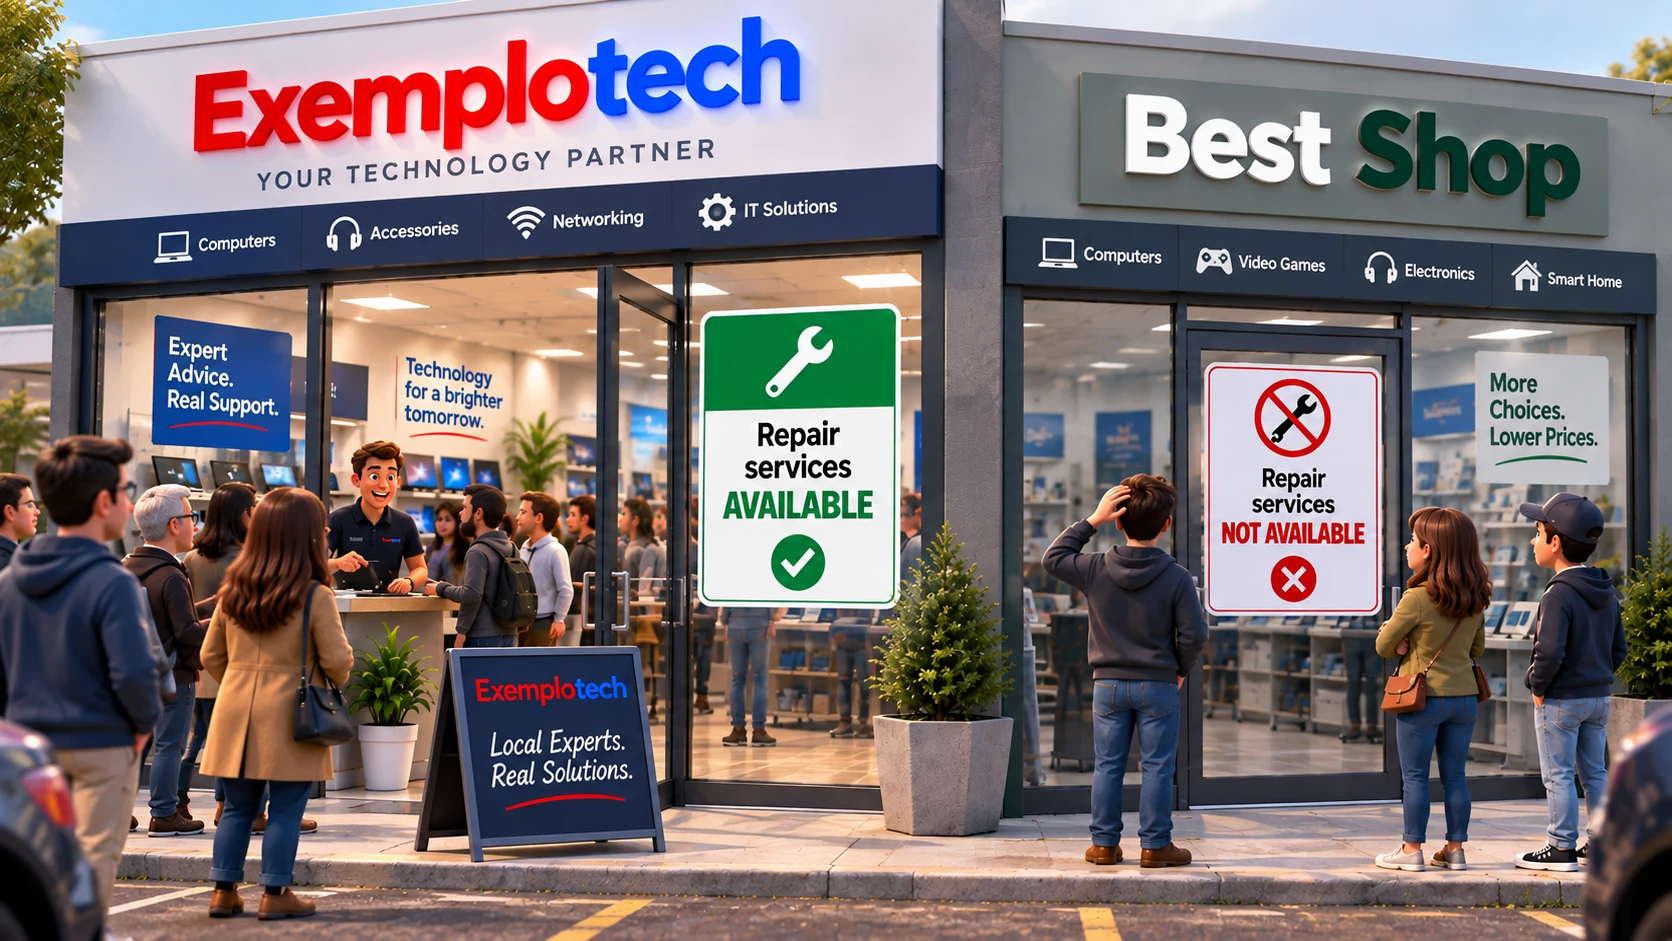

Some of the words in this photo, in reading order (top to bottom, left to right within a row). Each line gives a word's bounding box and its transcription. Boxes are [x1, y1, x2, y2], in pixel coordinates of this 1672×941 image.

[194, 16, 801, 152] Exemplotech
[257, 168, 331, 191] YOUR
[348, 151, 551, 183] TECHNOLOGY
[568, 139, 714, 167] PARTNER
[1126, 94, 1331, 185] Best
[1354, 110, 1581, 219] Shop
[554, 210, 643, 228] Networking
[745, 203, 759, 217] IT
[763, 200, 837, 216] Solutions
[370, 221, 459, 240] Accessories
[199, 235, 275, 252] Computers
[1084, 247, 1162, 265] Computers
[1239, 255, 1277, 269] Video
[1281, 257, 1325, 272] Games
[1406, 264, 1475, 280] Electronics
[1548, 272, 1584, 286] Smart
[1588, 275, 1622, 288] Home
[169, 336, 228, 362] Expert
[168, 363, 234, 388] Advice.
[405, 356, 493, 389] Technology
[1491, 373, 1537, 393] More
[168, 389, 206, 411] Real
[209, 393, 279, 418] Support.
[405, 380, 428, 399] for
[432, 389, 440, 401] a
[445, 385, 503, 409] brighter
[405, 405, 484, 429] tomorrow.
[1490, 399, 1565, 420] Choices.
[758, 420, 840, 452] Repair
[1491, 427, 1542, 446] Lower
[1546, 427, 1598, 446] Prices.
[745, 453, 851, 479] services
[1263, 468, 1326, 490] Repair
[723, 490, 873, 519] AVAILABLE
[1252, 493, 1335, 513] services
[1222, 522, 1261, 544] NOT
[1264, 522, 1365, 544] AVAILABLE
[476, 675, 628, 706] Exemplotech
[491, 730, 542, 757] Local
[550, 729, 625, 758] Experts.
[492, 761, 535, 788] Real
[543, 759, 632, 784] Solutions.
